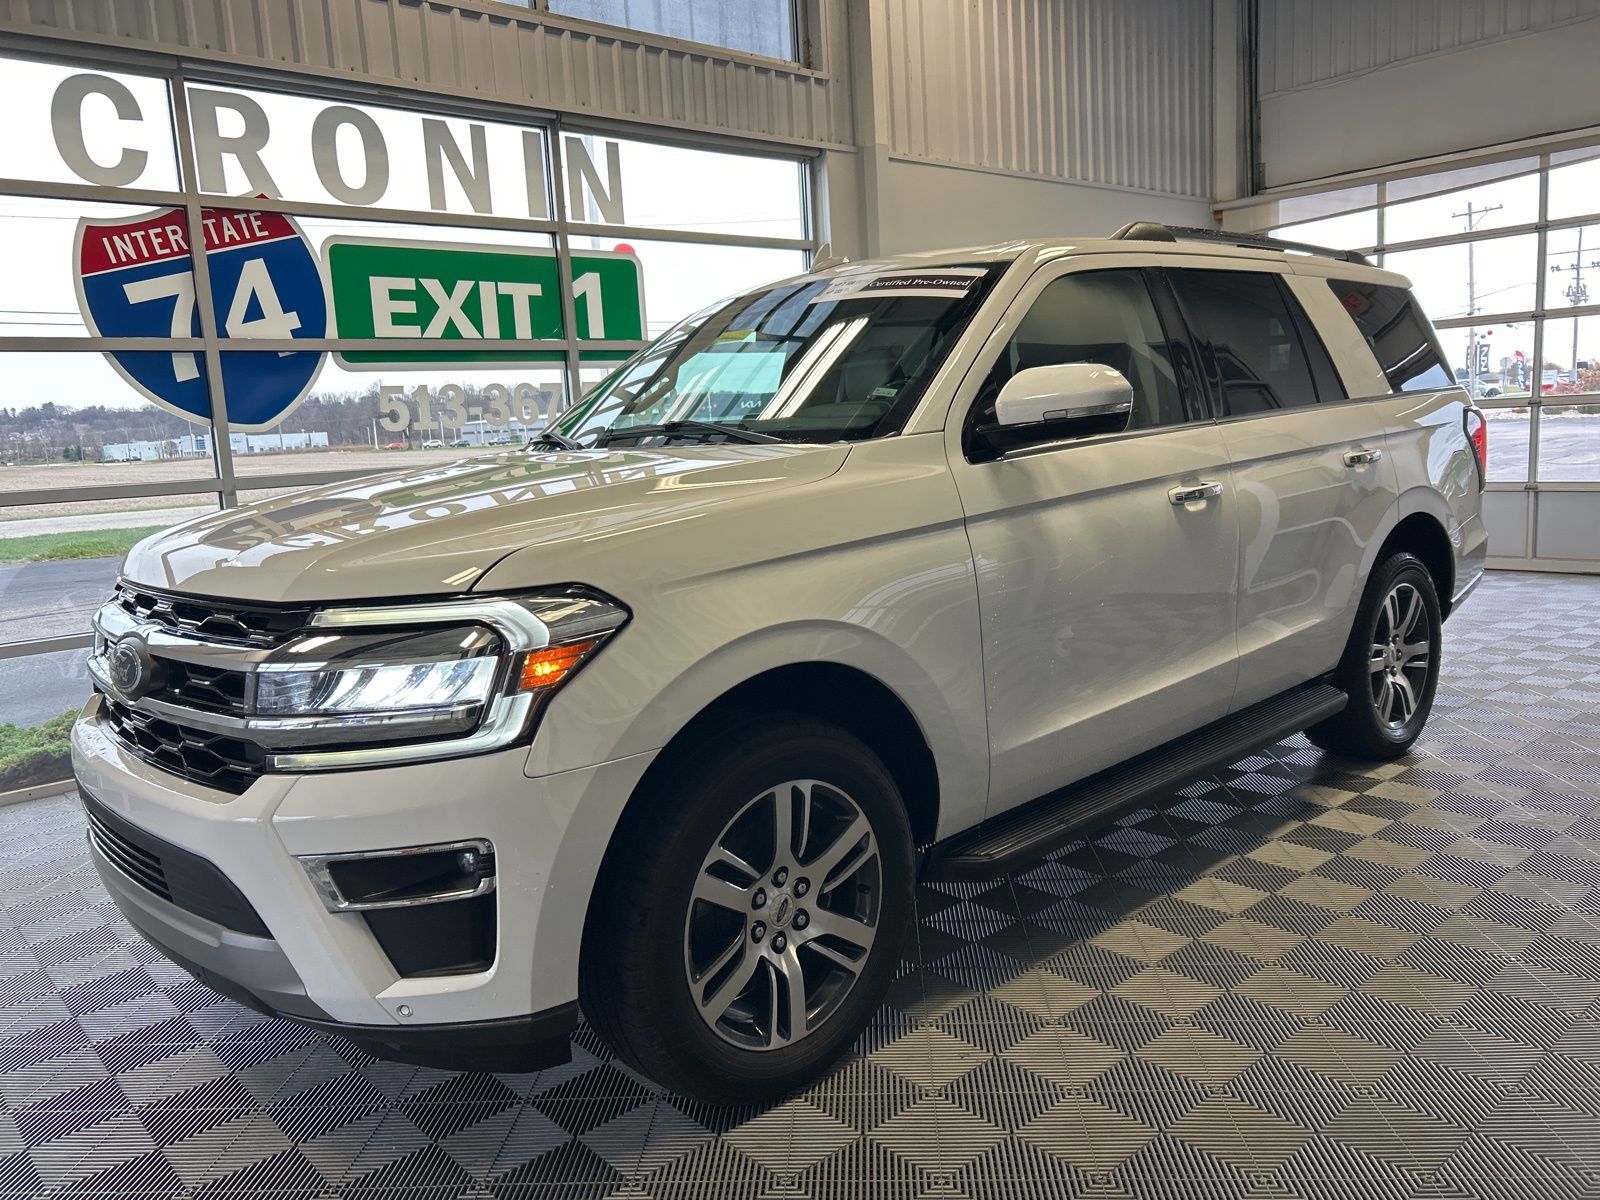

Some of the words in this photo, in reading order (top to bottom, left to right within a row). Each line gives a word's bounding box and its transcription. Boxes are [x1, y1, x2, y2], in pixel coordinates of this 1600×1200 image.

[51, 73, 625, 225] CRONIN
[102, 211, 269, 264] INTERTATE
[369, 275, 542, 339] EXIT
[571, 272, 605, 340] 1
[869, 278, 912, 289] Certified
[912, 278, 971, 287] Pre-Owned
[122, 257, 302, 383] 74
